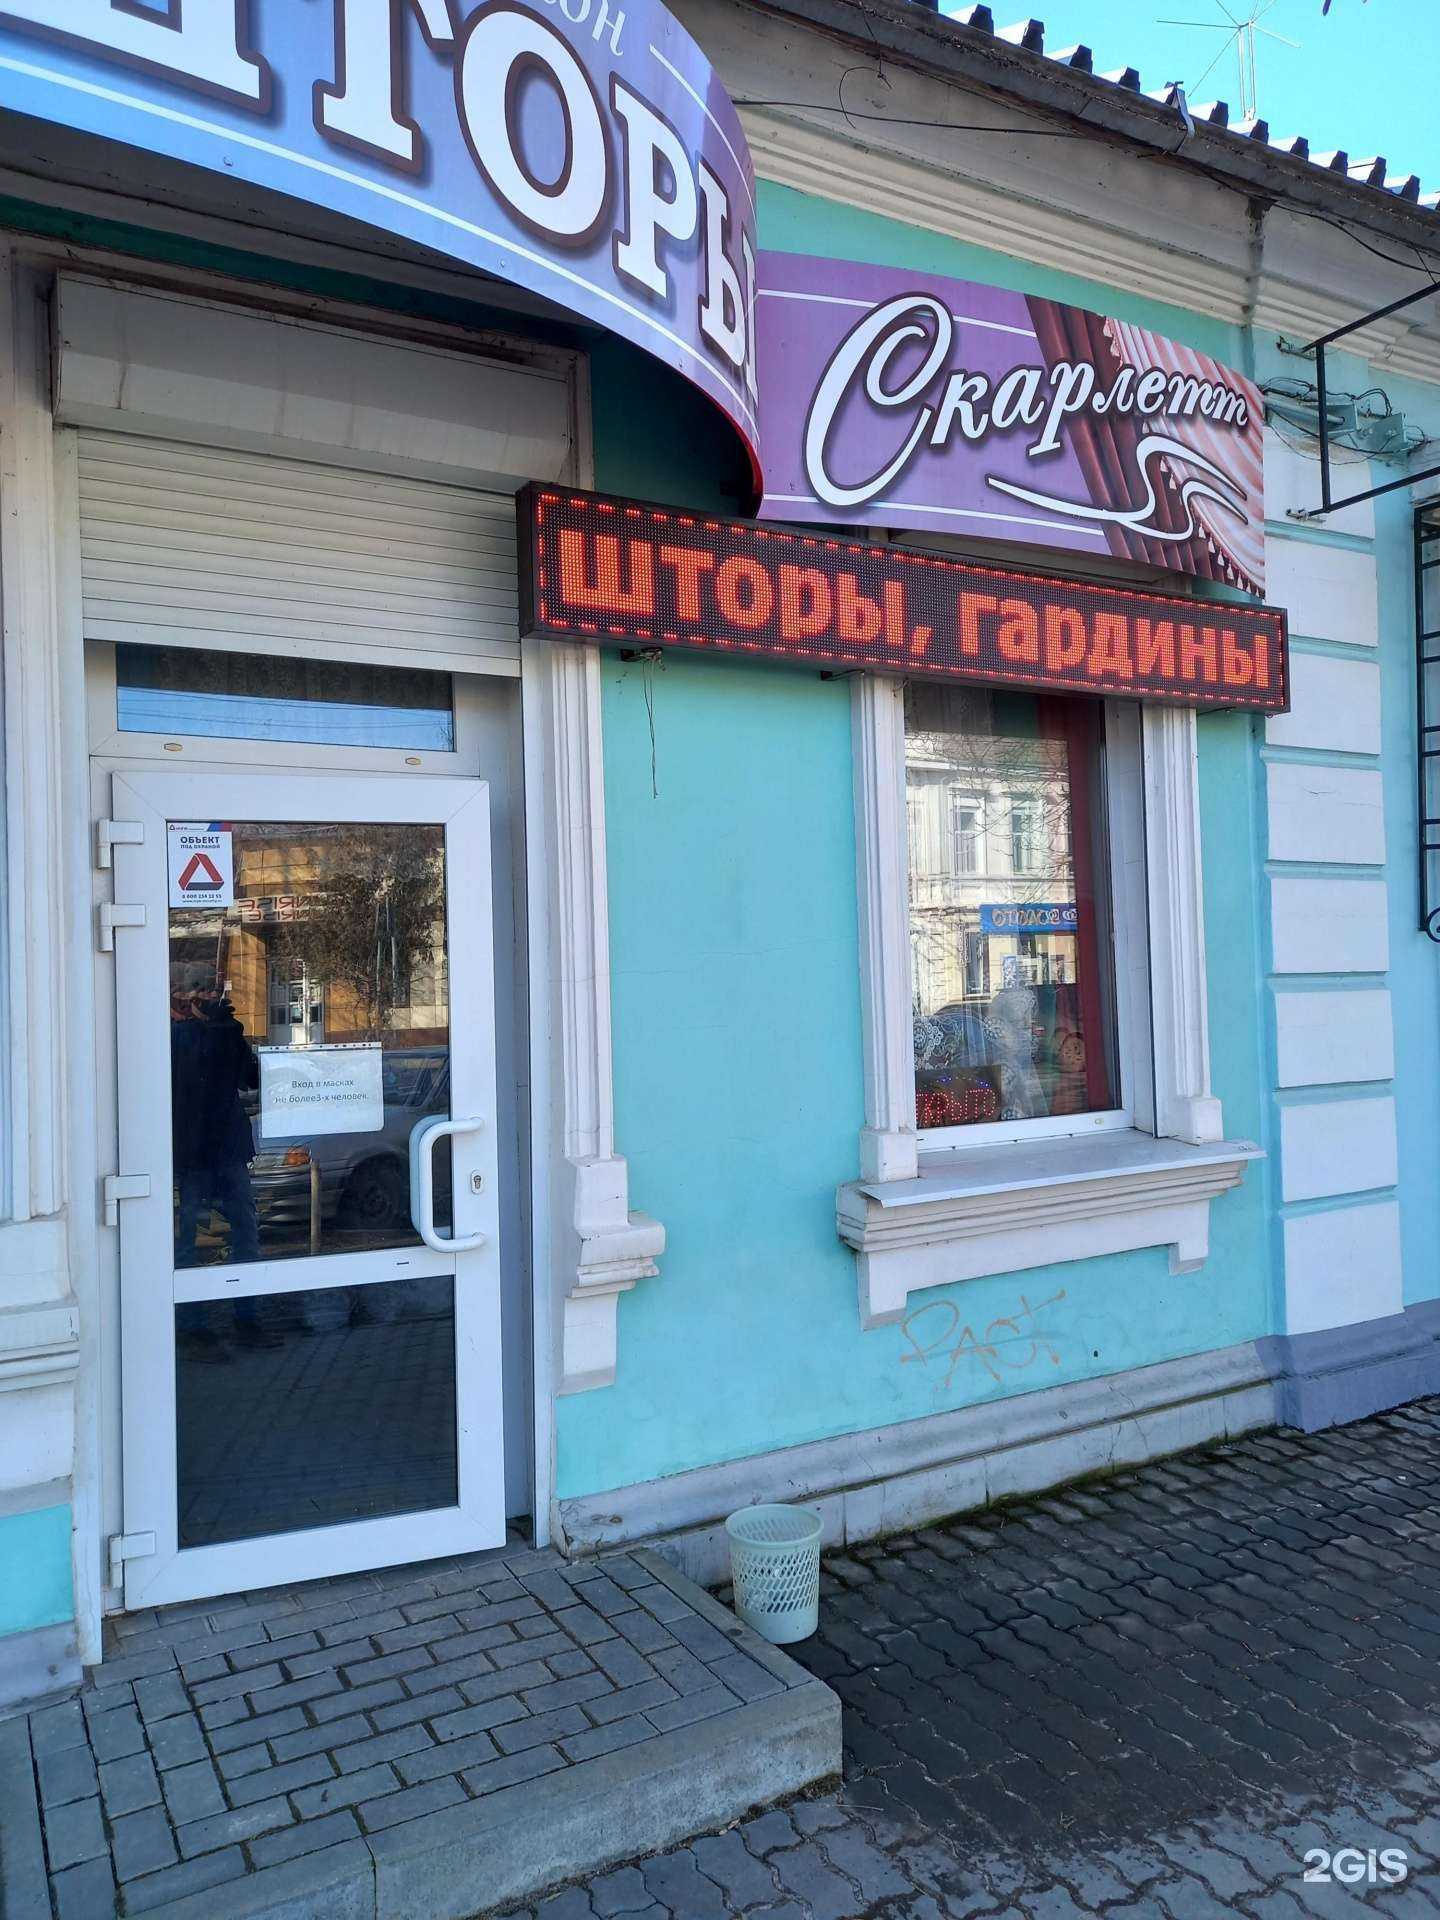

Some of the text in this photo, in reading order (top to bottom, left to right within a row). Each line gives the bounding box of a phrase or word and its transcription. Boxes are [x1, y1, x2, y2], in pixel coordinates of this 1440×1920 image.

[804, 295, 1249, 506] Скарлетт
[958, 590, 1270, 689] гардины
[180, 836, 220, 844] ОБЪЕКТ
[291, 1080, 314, 1089] Вход
[322, 1079, 355, 1088] масках
